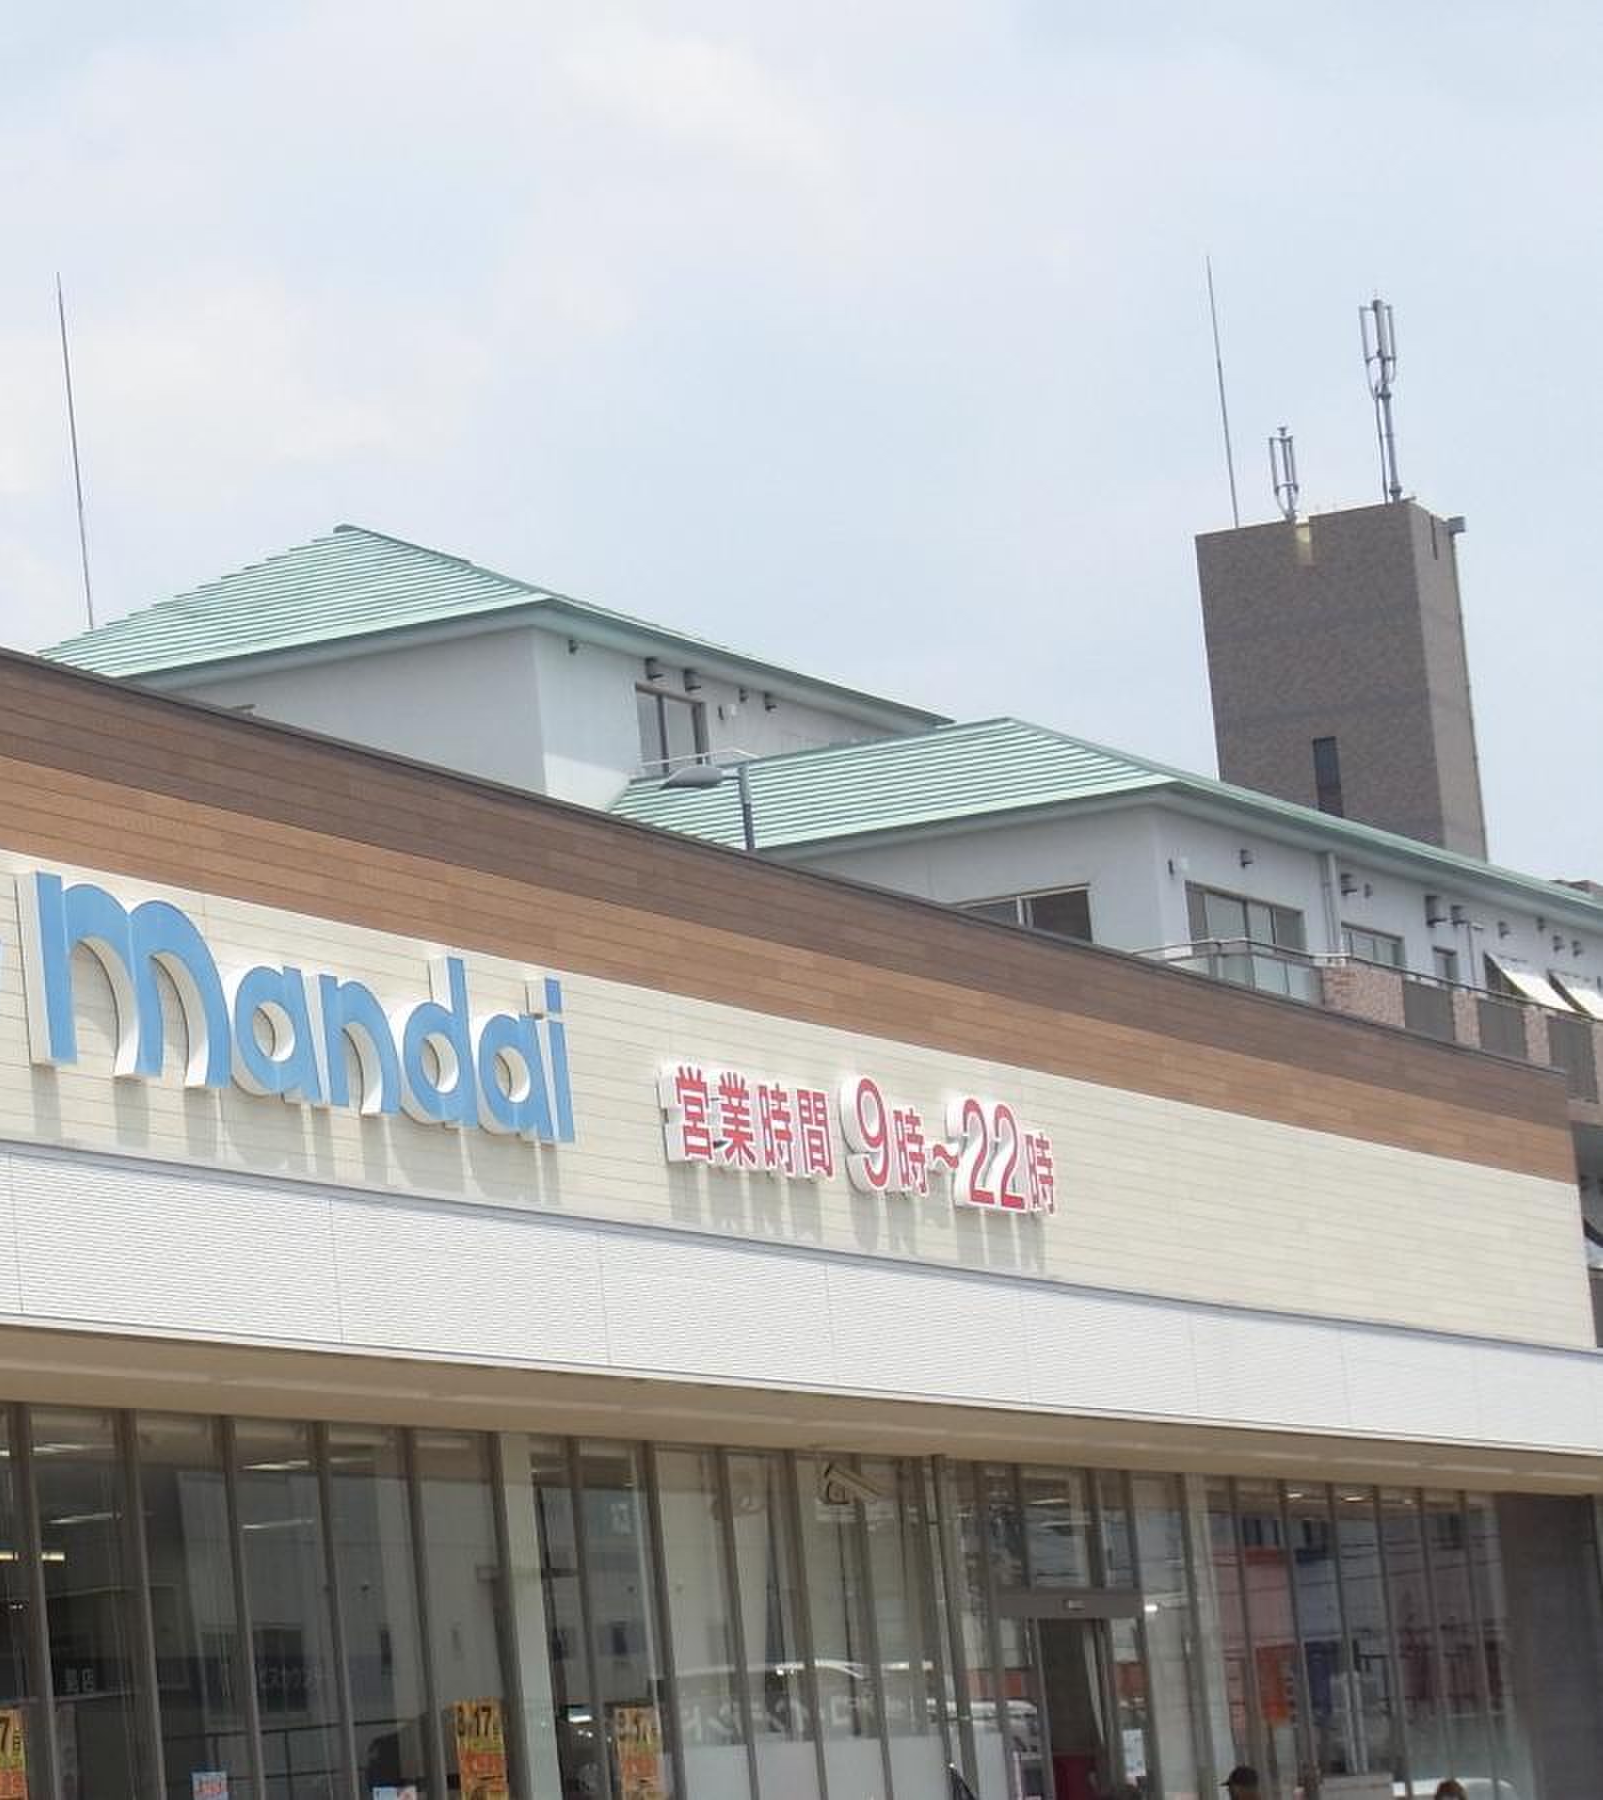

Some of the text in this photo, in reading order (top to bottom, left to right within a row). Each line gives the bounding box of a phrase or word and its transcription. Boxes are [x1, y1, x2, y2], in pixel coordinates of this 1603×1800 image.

[35, 870, 576, 1145] mandai
[673, 1064, 836, 1180] 営業時間
